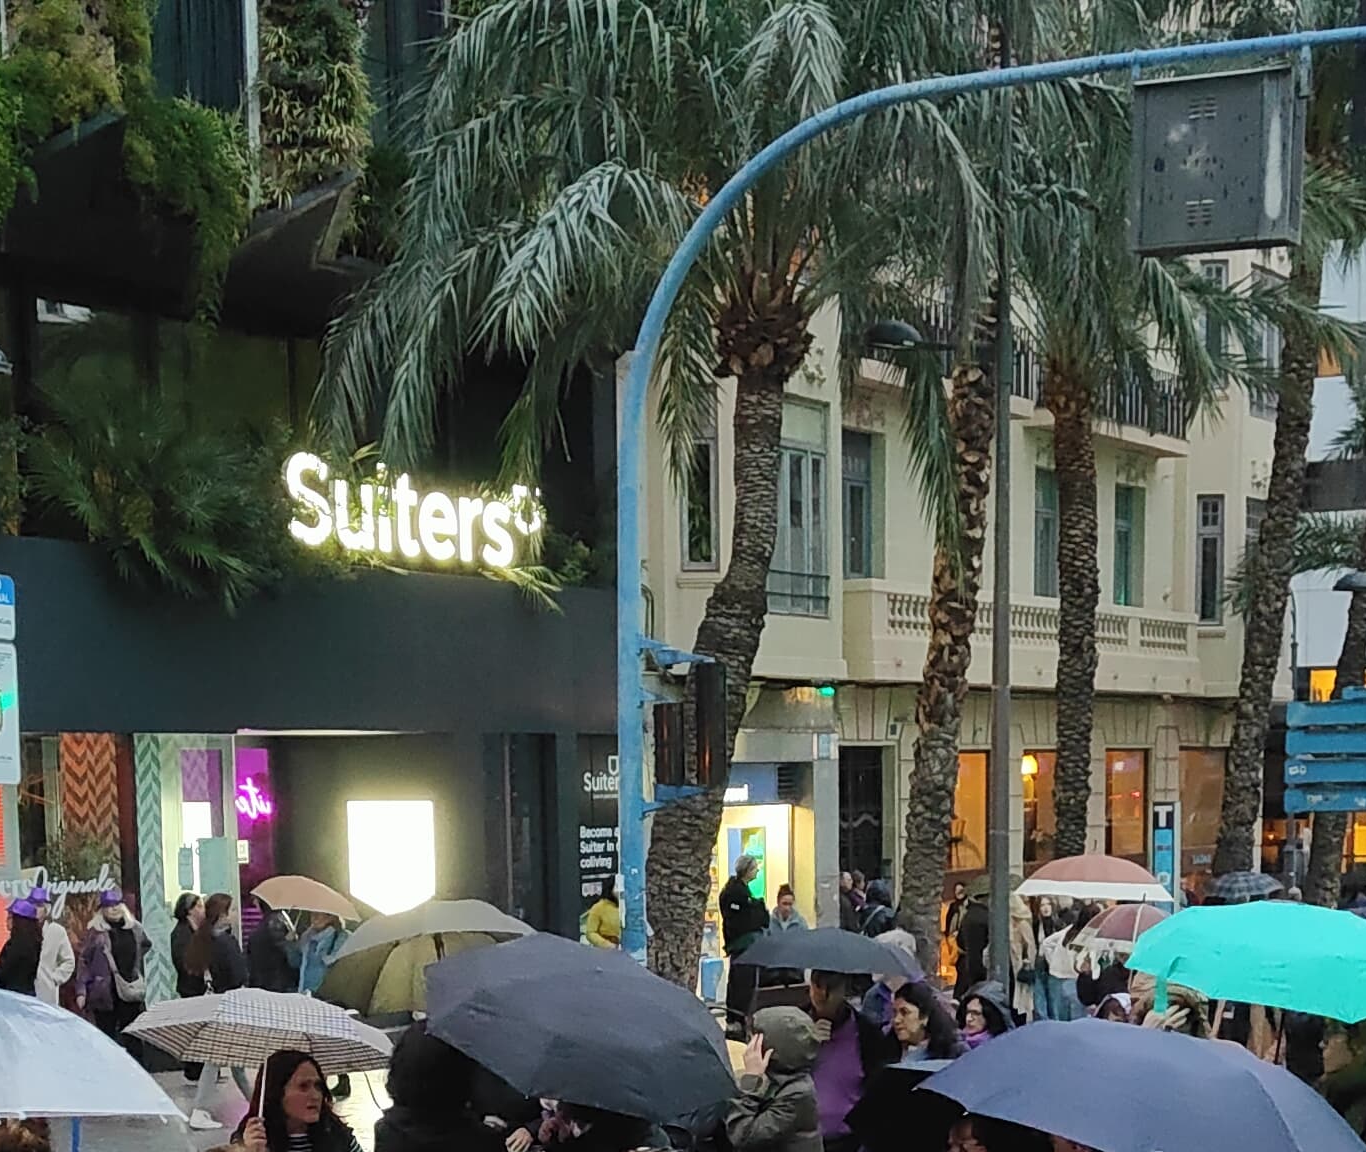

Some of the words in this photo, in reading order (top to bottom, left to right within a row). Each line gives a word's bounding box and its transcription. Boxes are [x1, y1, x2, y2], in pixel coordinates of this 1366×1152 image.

[583, 771, 619, 792] Suiter
[1153, 805, 1173, 828] T
[579, 825, 613, 839] Become
[579, 840, 605, 854] Suiter
[606, 839, 615, 852] in
[579, 854, 612, 869] coliving
